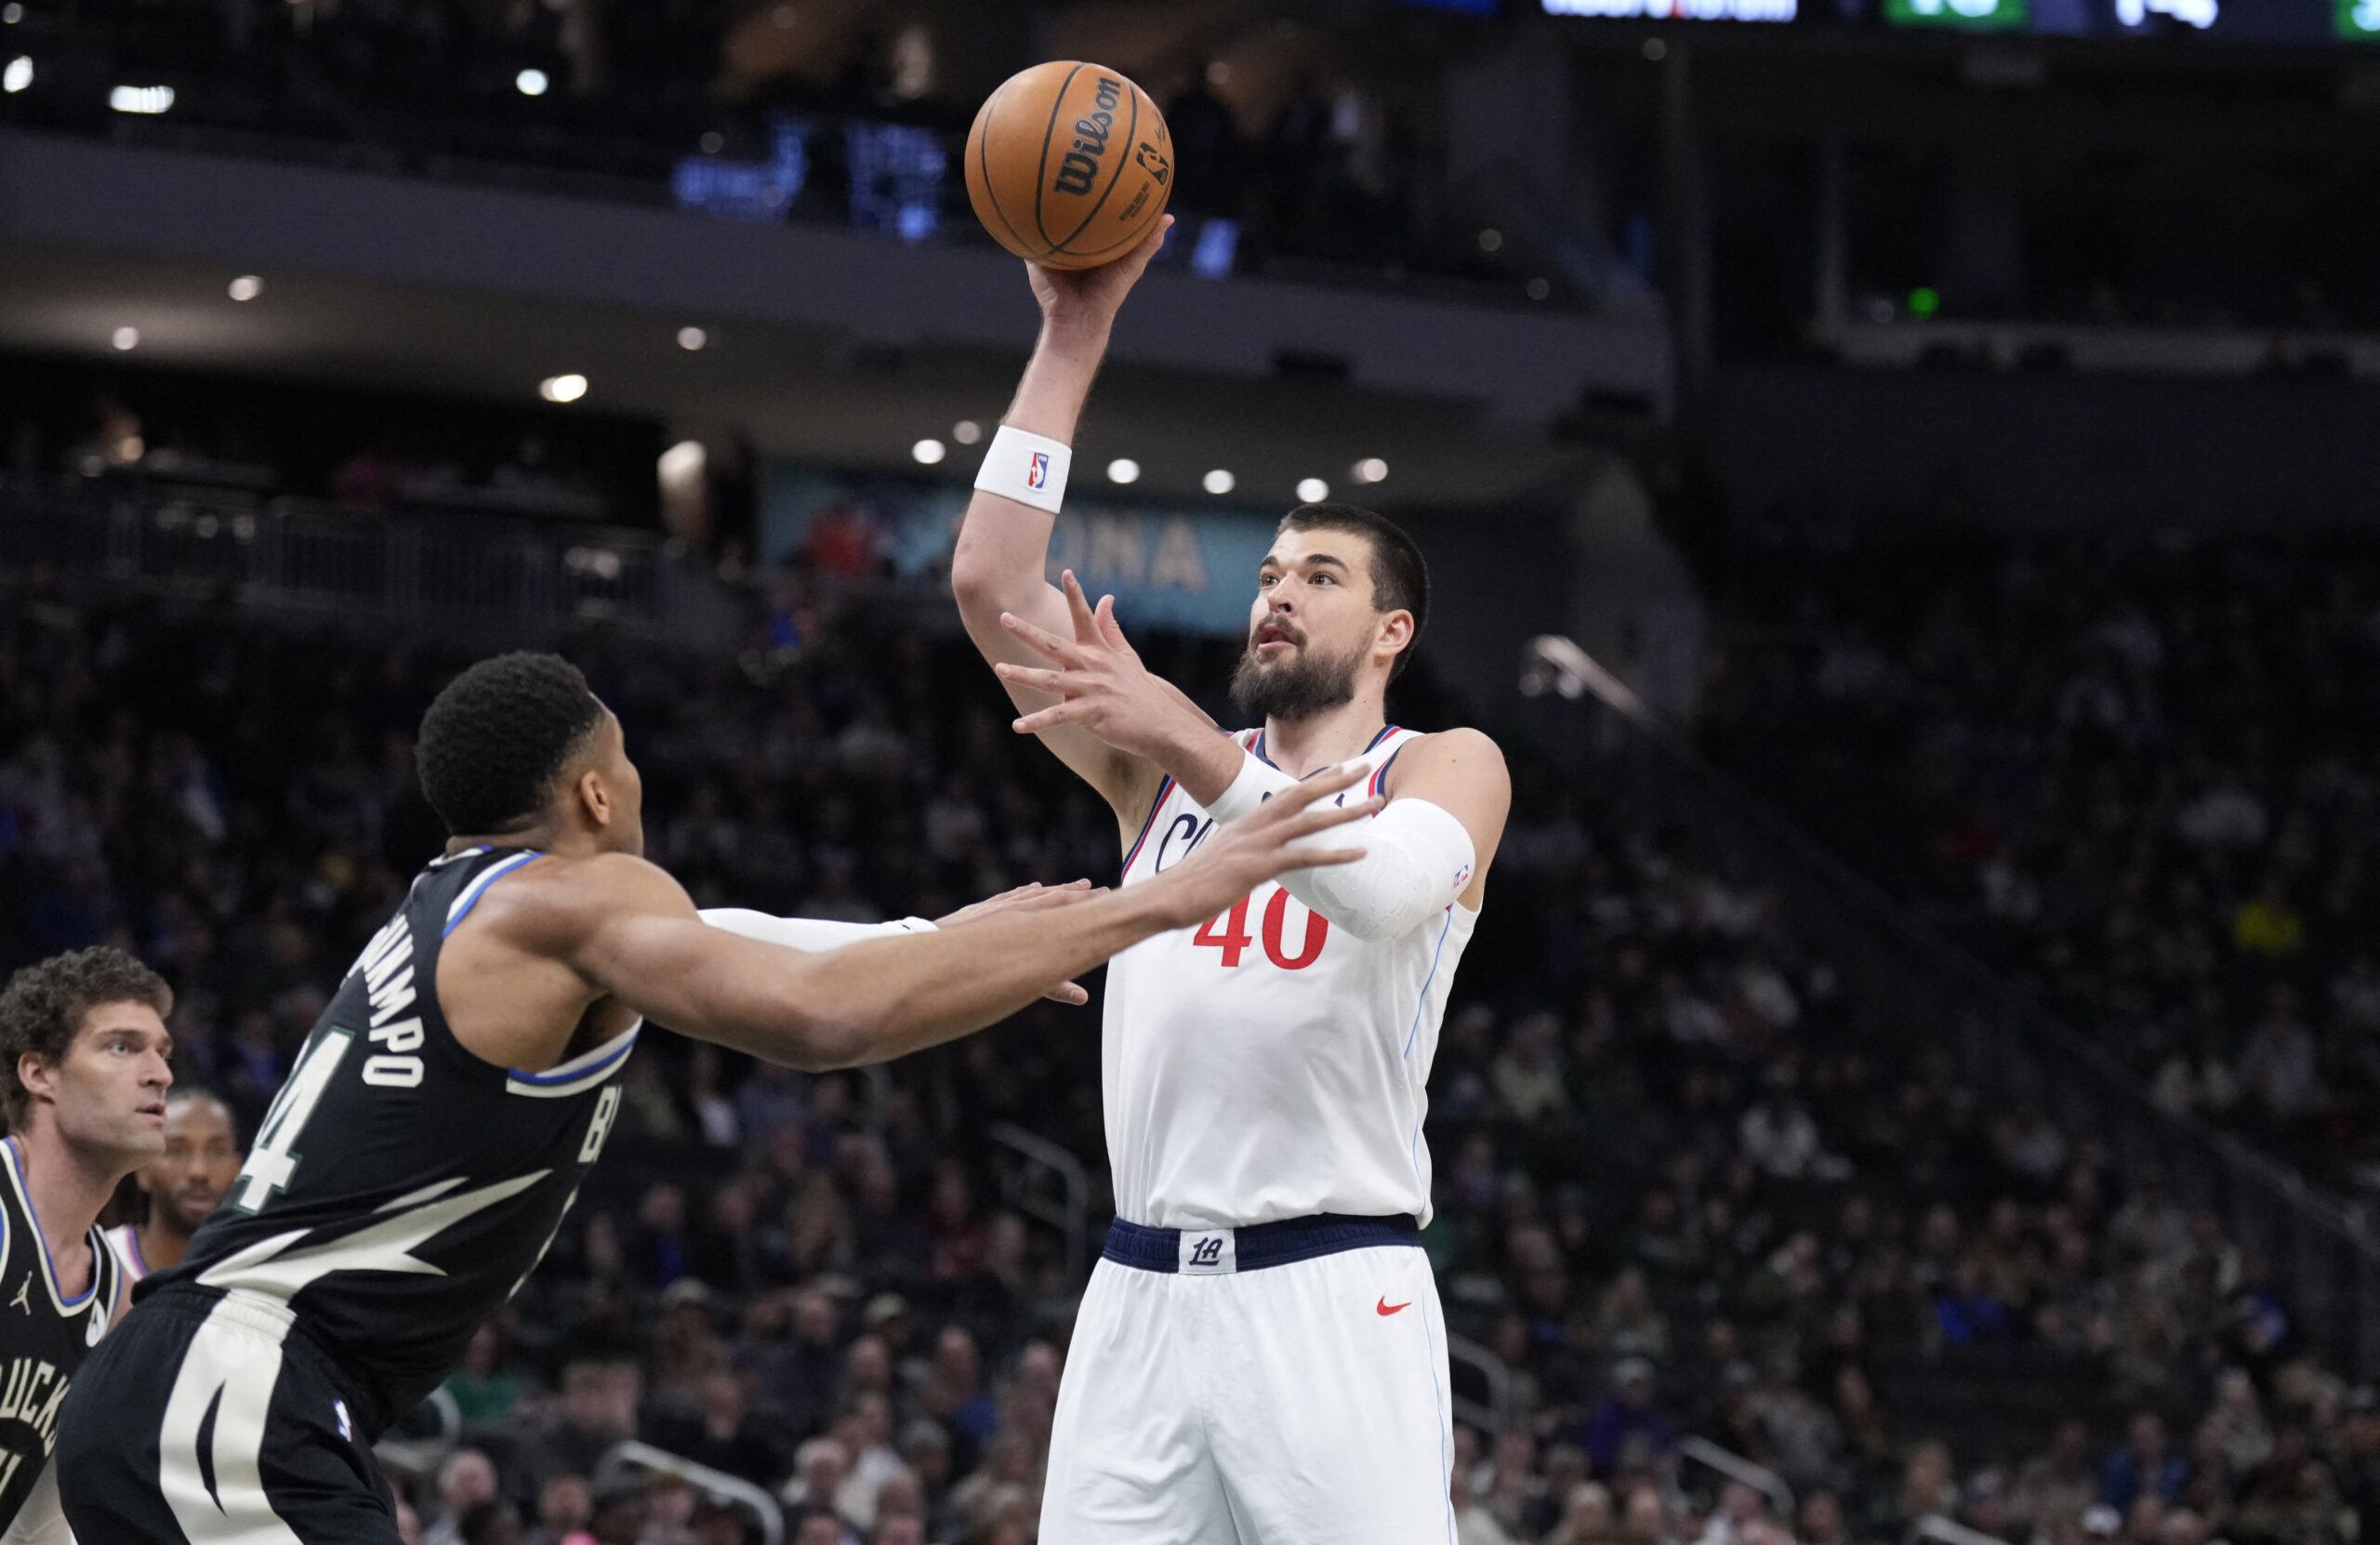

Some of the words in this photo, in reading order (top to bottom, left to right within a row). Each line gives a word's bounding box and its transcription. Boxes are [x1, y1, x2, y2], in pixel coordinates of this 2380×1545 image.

[1052, 77, 1121, 197] Wilson
[1193, 885, 1329, 970] 40
[234, 1024, 355, 1216] 4
[577, 1086, 622, 1163] B
[1188, 1236, 1223, 1266] LA
[0, 1357, 71, 1459] UCK
